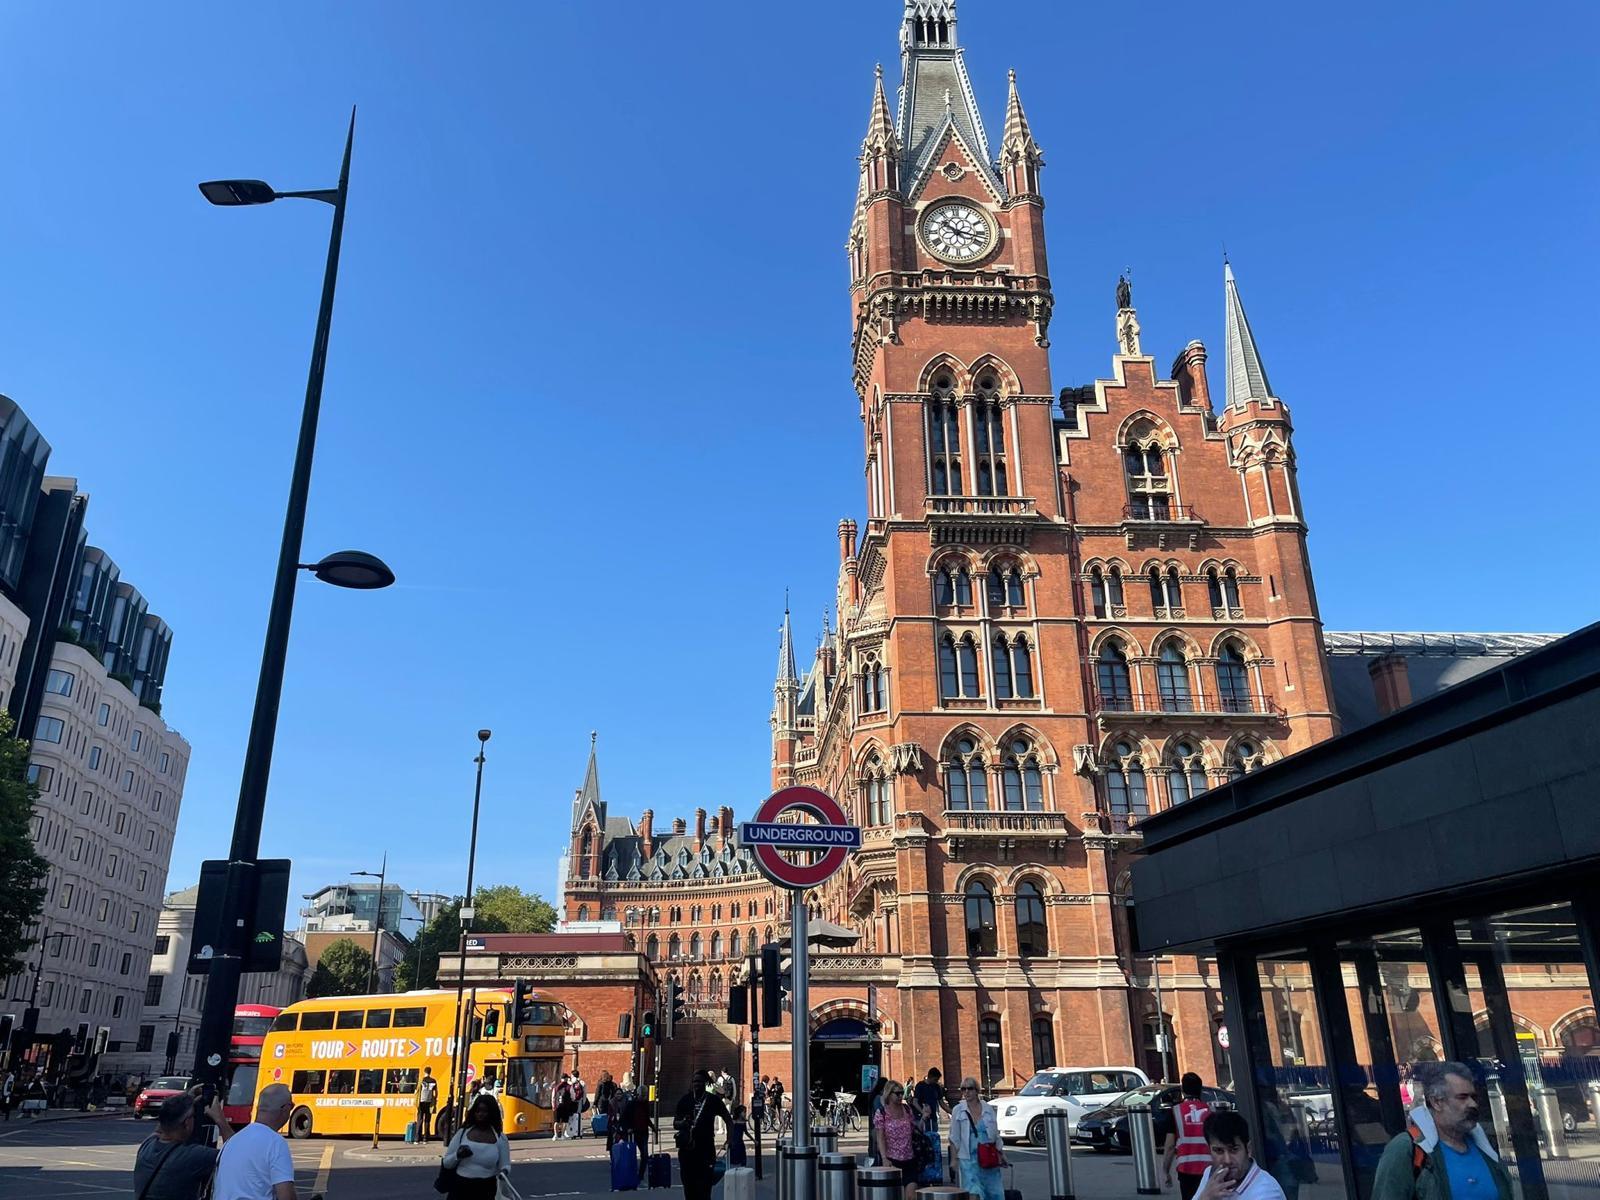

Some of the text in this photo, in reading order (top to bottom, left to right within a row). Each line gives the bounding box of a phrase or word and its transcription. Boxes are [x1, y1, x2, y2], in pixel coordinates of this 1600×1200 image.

[749, 827, 854, 843] UNDERGROUND
[311, 1040, 344, 1059] YOUR
[361, 1039, 406, 1058] ROUTE
[425, 1037, 443, 1056] TO
